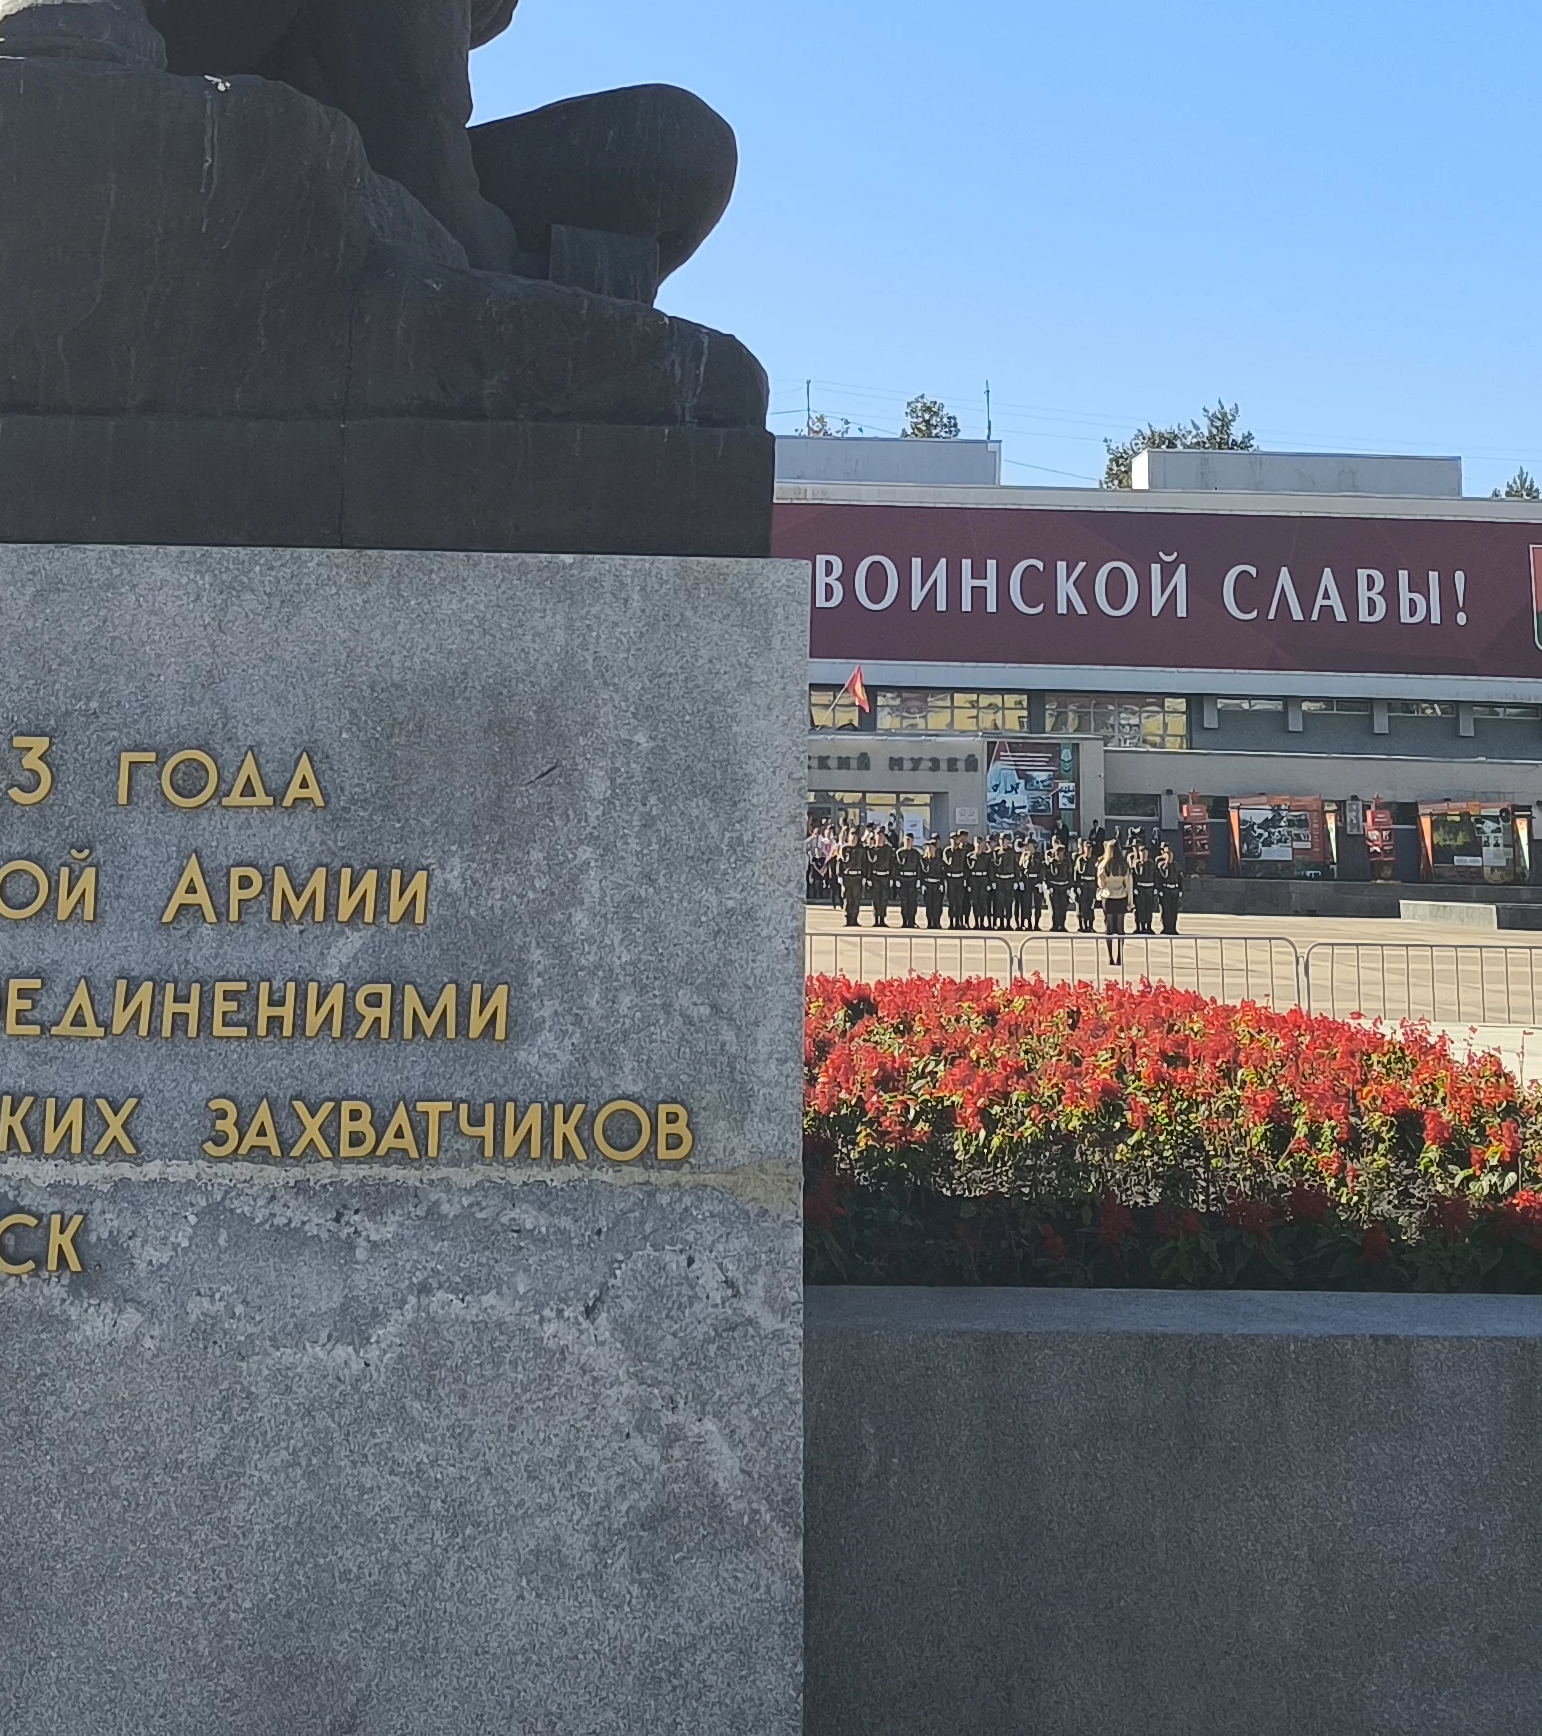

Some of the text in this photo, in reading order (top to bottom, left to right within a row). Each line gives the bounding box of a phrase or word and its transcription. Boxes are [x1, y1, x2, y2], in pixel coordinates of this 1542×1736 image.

[814, 551, 1468, 626] ВОИНСКОЙ СЛАВЫ!
[116, 749, 326, 808] ГОДА
[888, 754, 979, 773] МУЗЕЙ
[161, 852, 429, 925] АРМИИ
[202, 1097, 694, 1161] ЗАХВАТЧИКОВ
